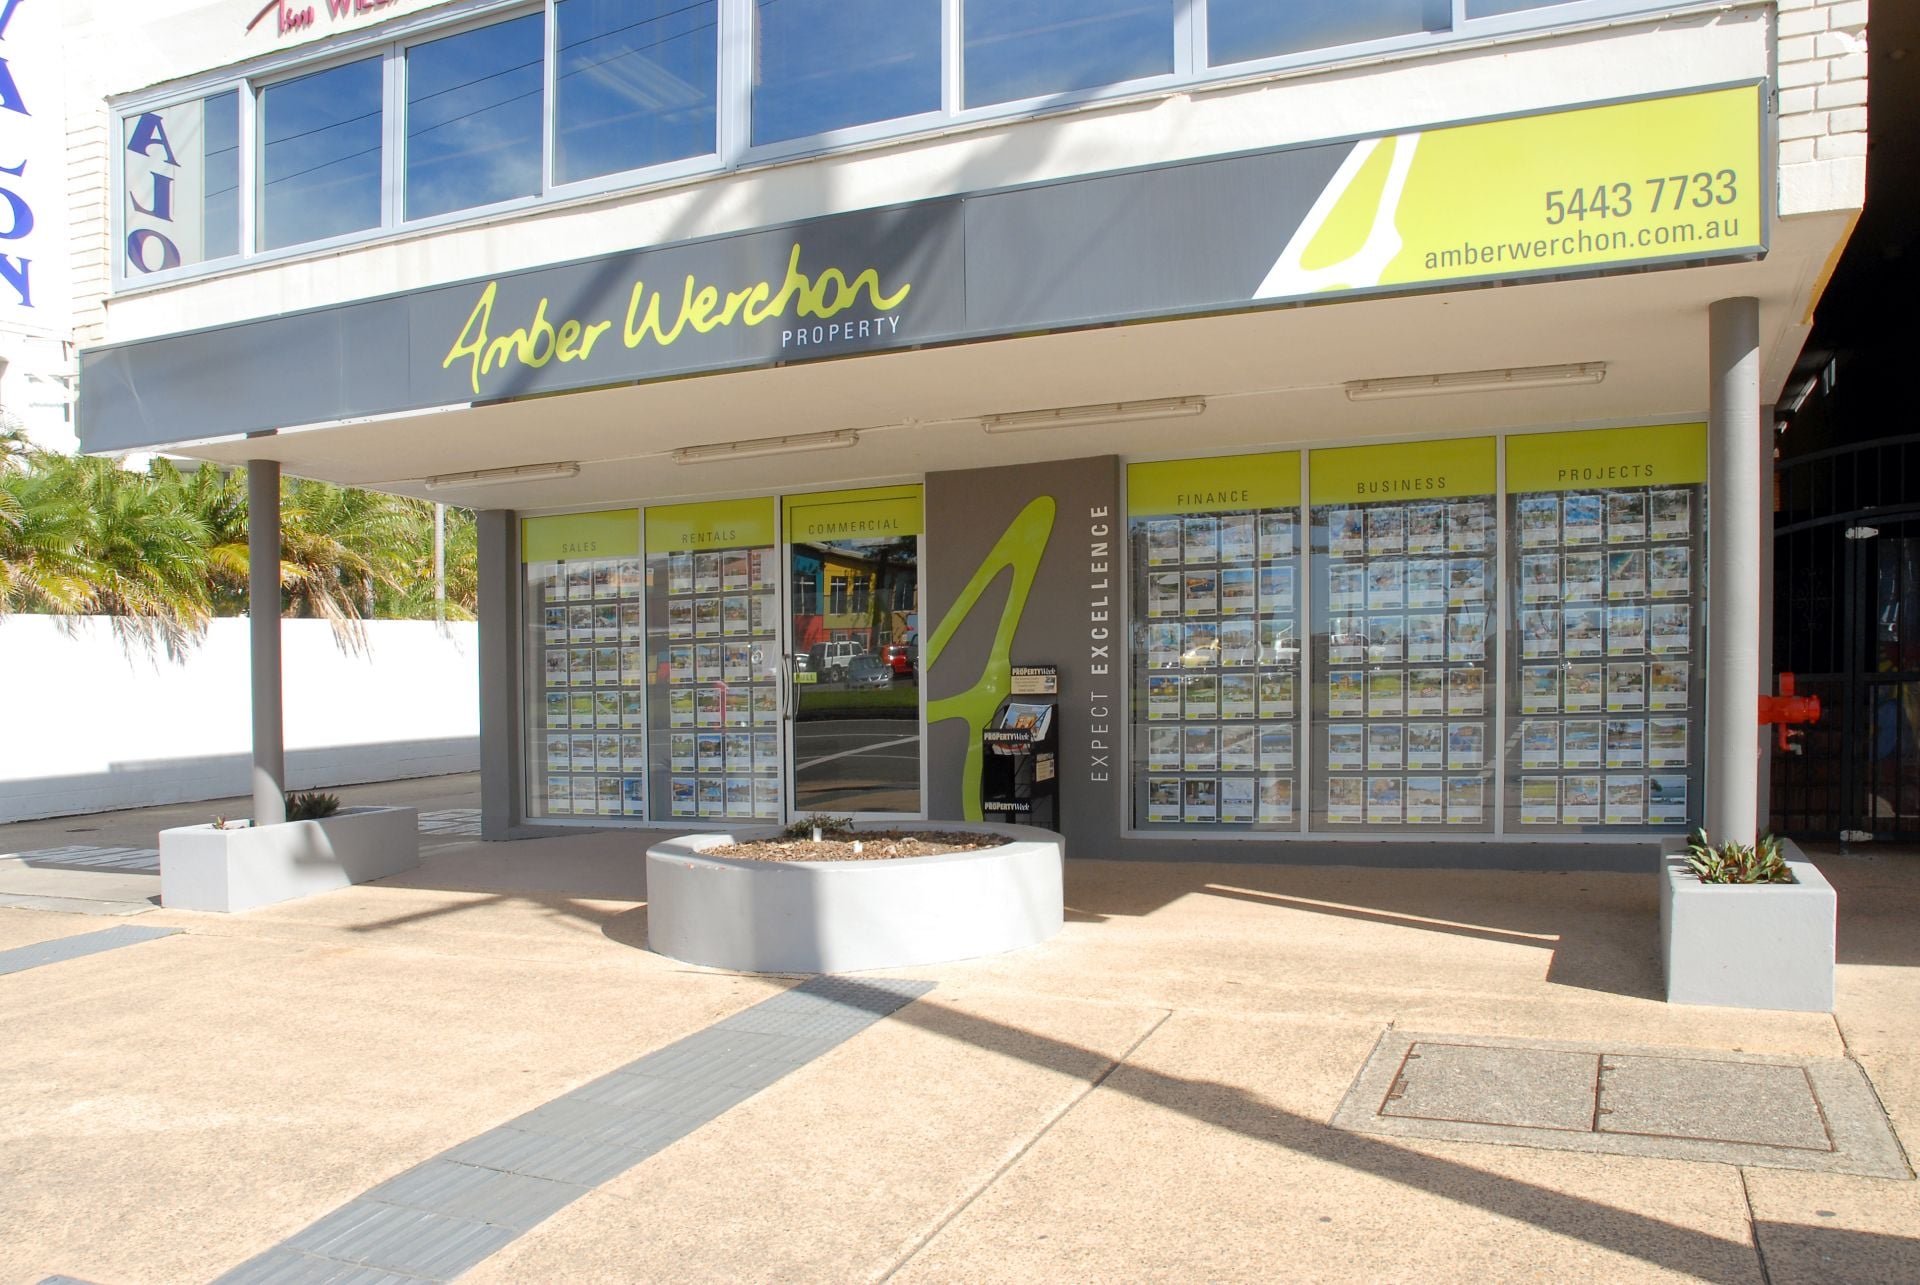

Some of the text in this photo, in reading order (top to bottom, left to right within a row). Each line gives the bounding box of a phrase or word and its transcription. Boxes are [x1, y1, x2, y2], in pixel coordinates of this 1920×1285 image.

[1545, 168, 1737, 225] 5443 7733
[1424, 217, 1739, 269] amberwerchon.com.au
[443, 243, 911, 394] Amber Werchon
[781, 315, 902, 348] PROPERTY
[1558, 464, 1653, 481] PROJECTS
[1357, 477, 1446, 494] BUSINESS
[1177, 490, 1249, 506] FINANCE
[808, 518, 899, 535] COMMERCIAL
[682, 529, 736, 544] RENTALS
[562, 541, 597, 553] SALES
[1091, 506, 1109, 781] EXPECT EXCELLENCE
